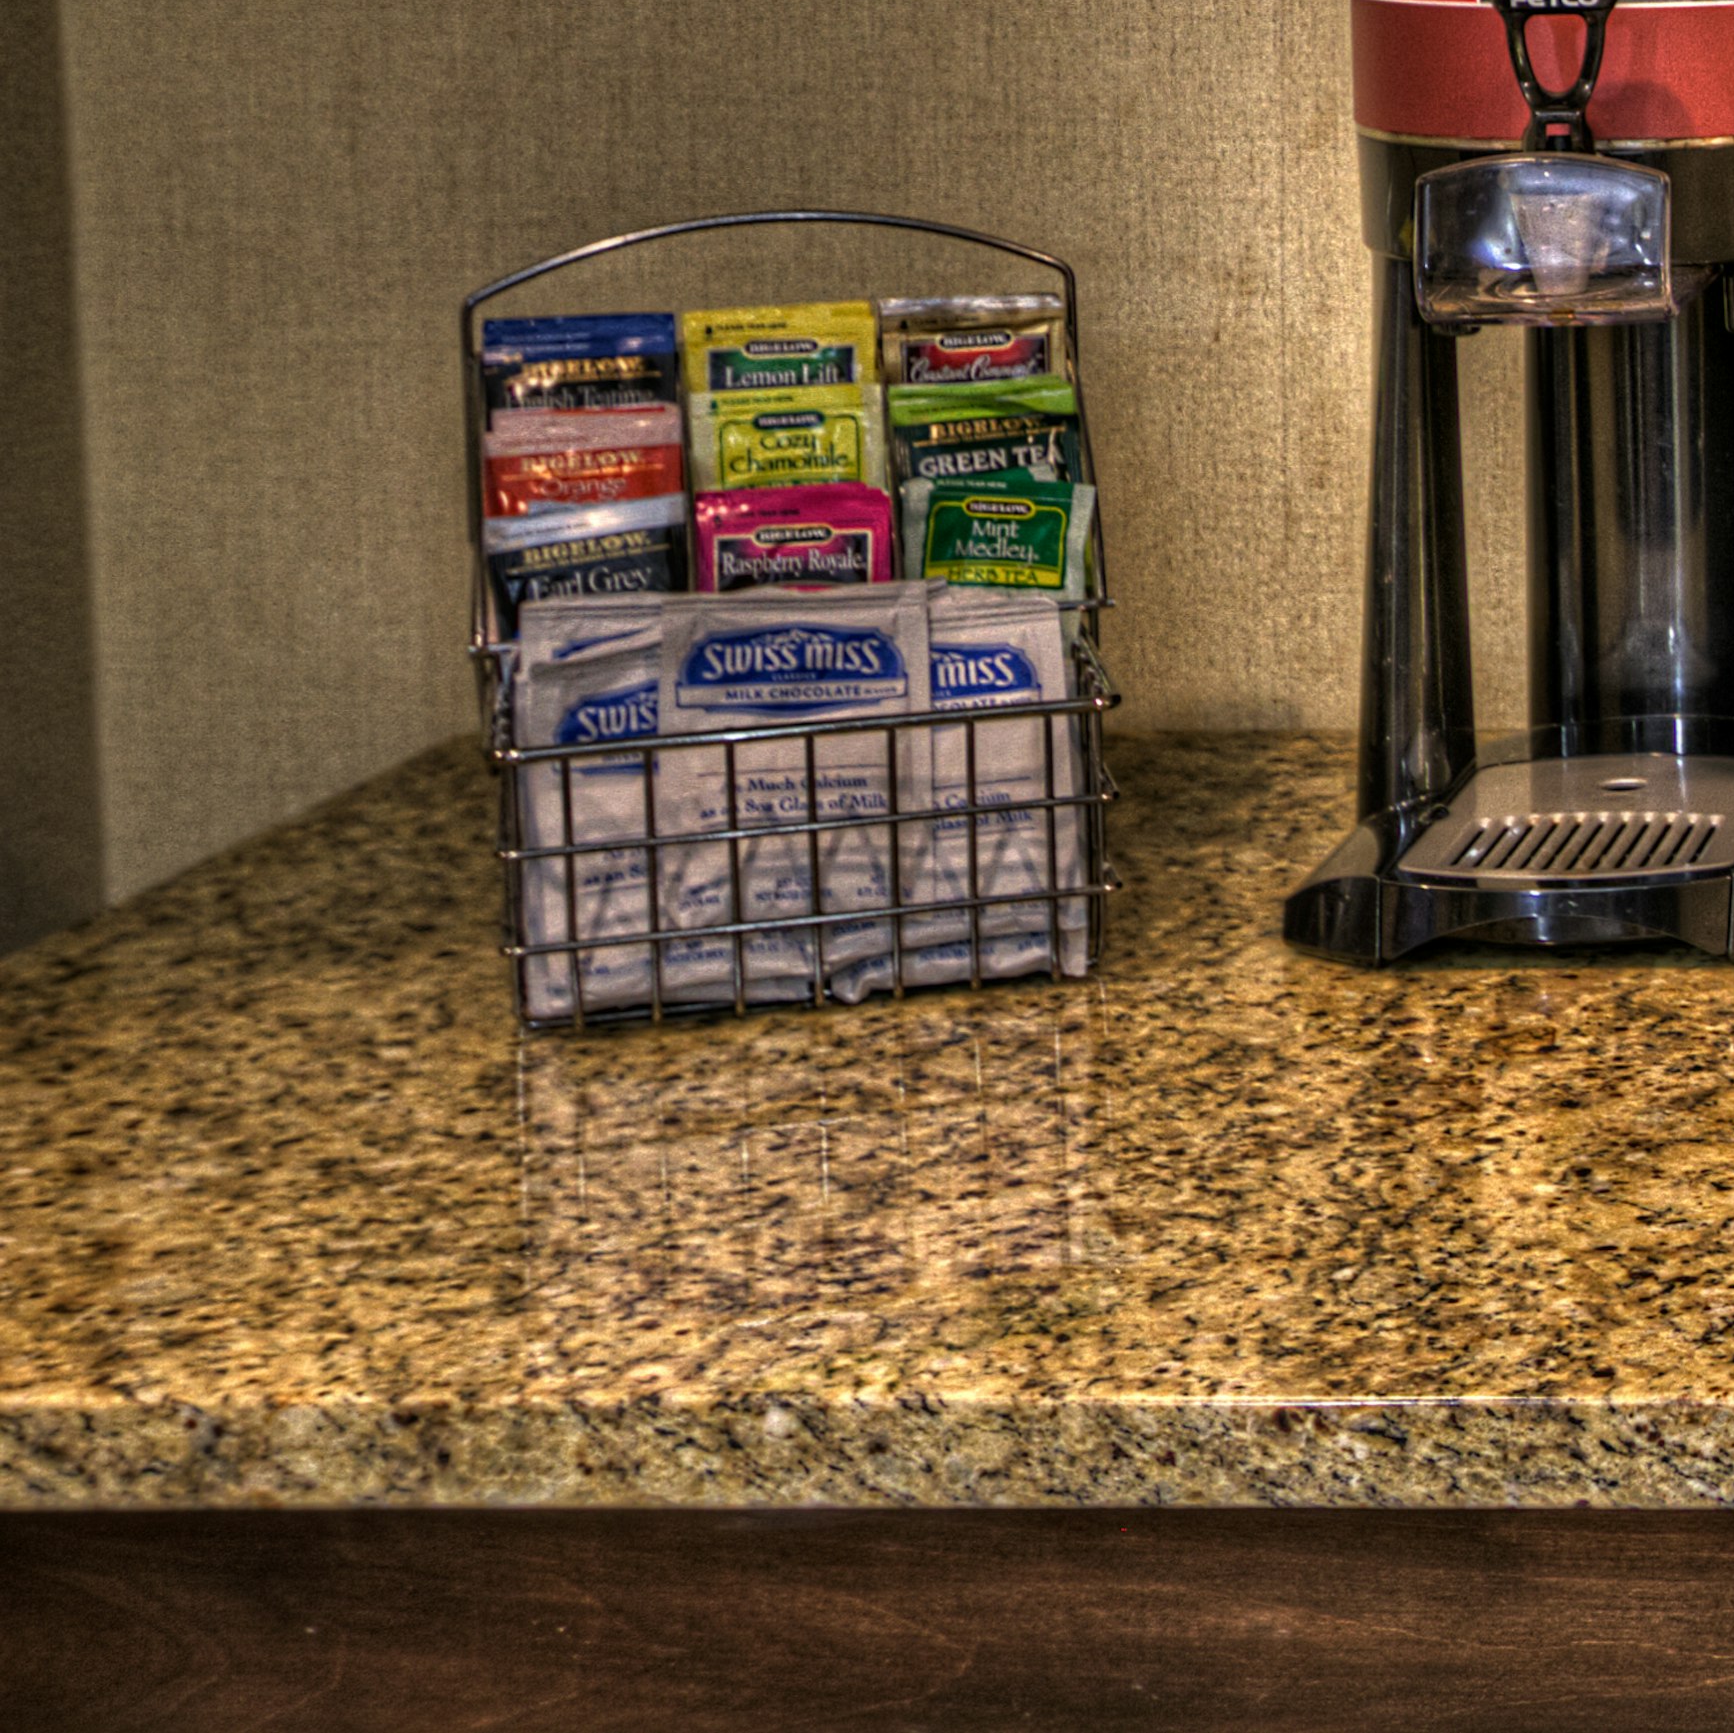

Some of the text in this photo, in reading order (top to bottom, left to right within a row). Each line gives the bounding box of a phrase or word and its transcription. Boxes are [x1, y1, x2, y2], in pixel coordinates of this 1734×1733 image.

[725, 363, 838, 388] Lemon Lift
[919, 440, 1064, 478] GREEN TEA
[540, 476, 627, 499] Orange
[972, 519, 1019, 539] Mint
[722, 549, 803, 578] Raspberry
[588, 566, 653, 593] Grey
[702, 642, 797, 680] SWISS
[725, 688, 764, 701] MILK
[768, 684, 860, 700] CHOCOLATE
[747, 776, 795, 791] Much
[848, 793, 887, 809] Milk
